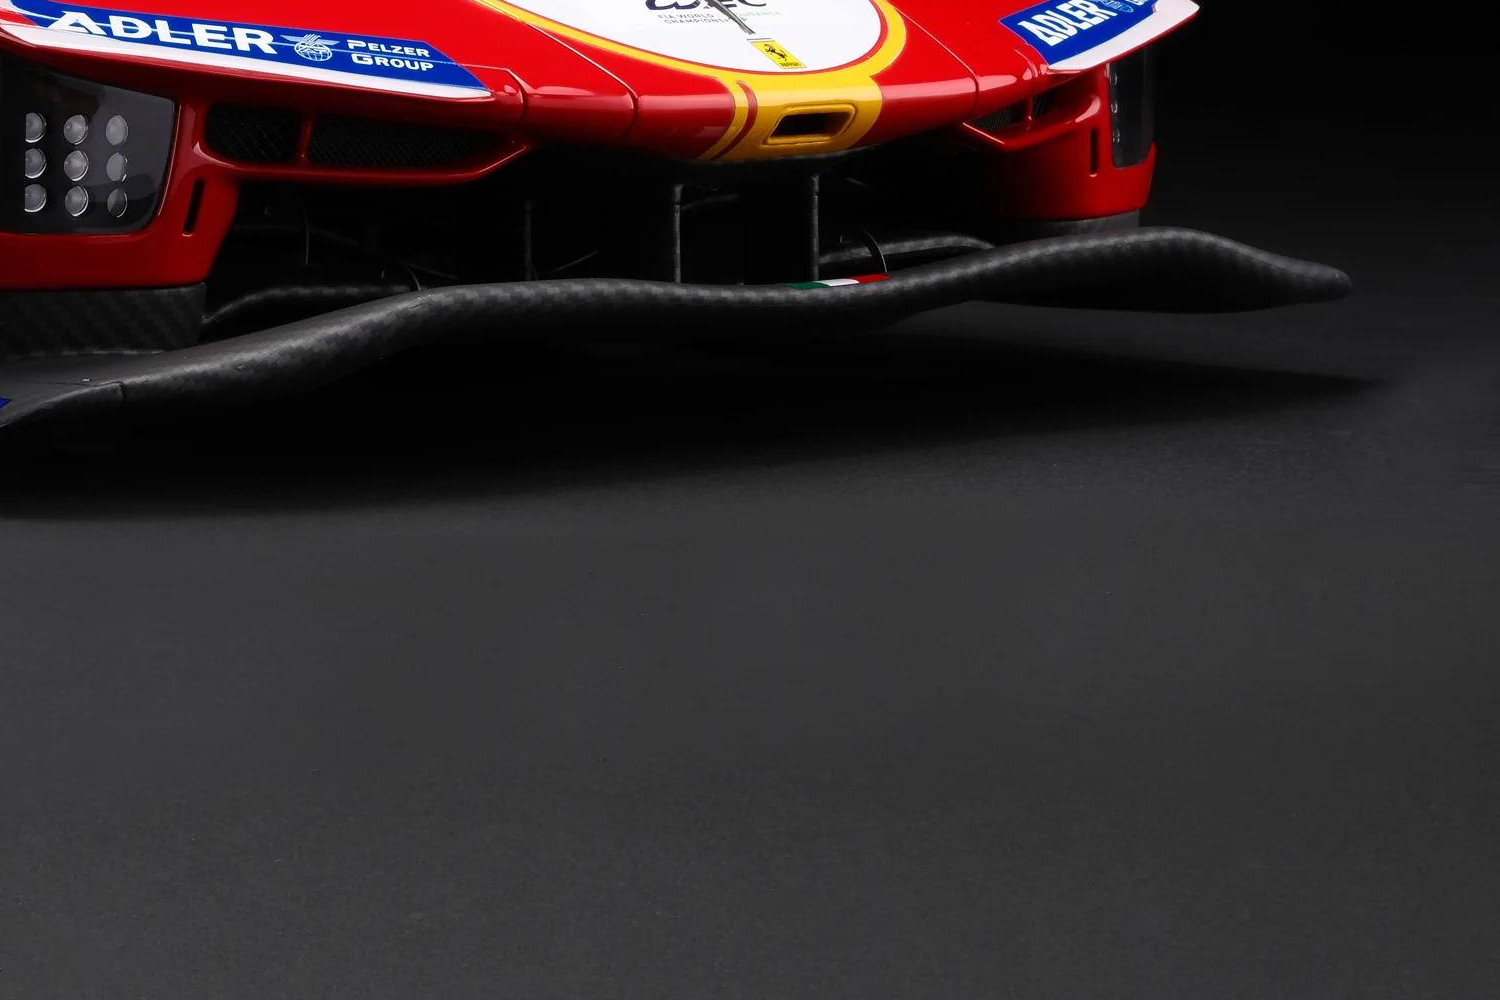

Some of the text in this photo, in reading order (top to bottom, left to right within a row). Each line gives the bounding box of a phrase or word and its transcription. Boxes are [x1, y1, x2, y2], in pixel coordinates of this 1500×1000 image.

[47, 10, 278, 55] ADLER
[347, 39, 430, 58] PELZER
[351, 54, 434, 72] GROUP
